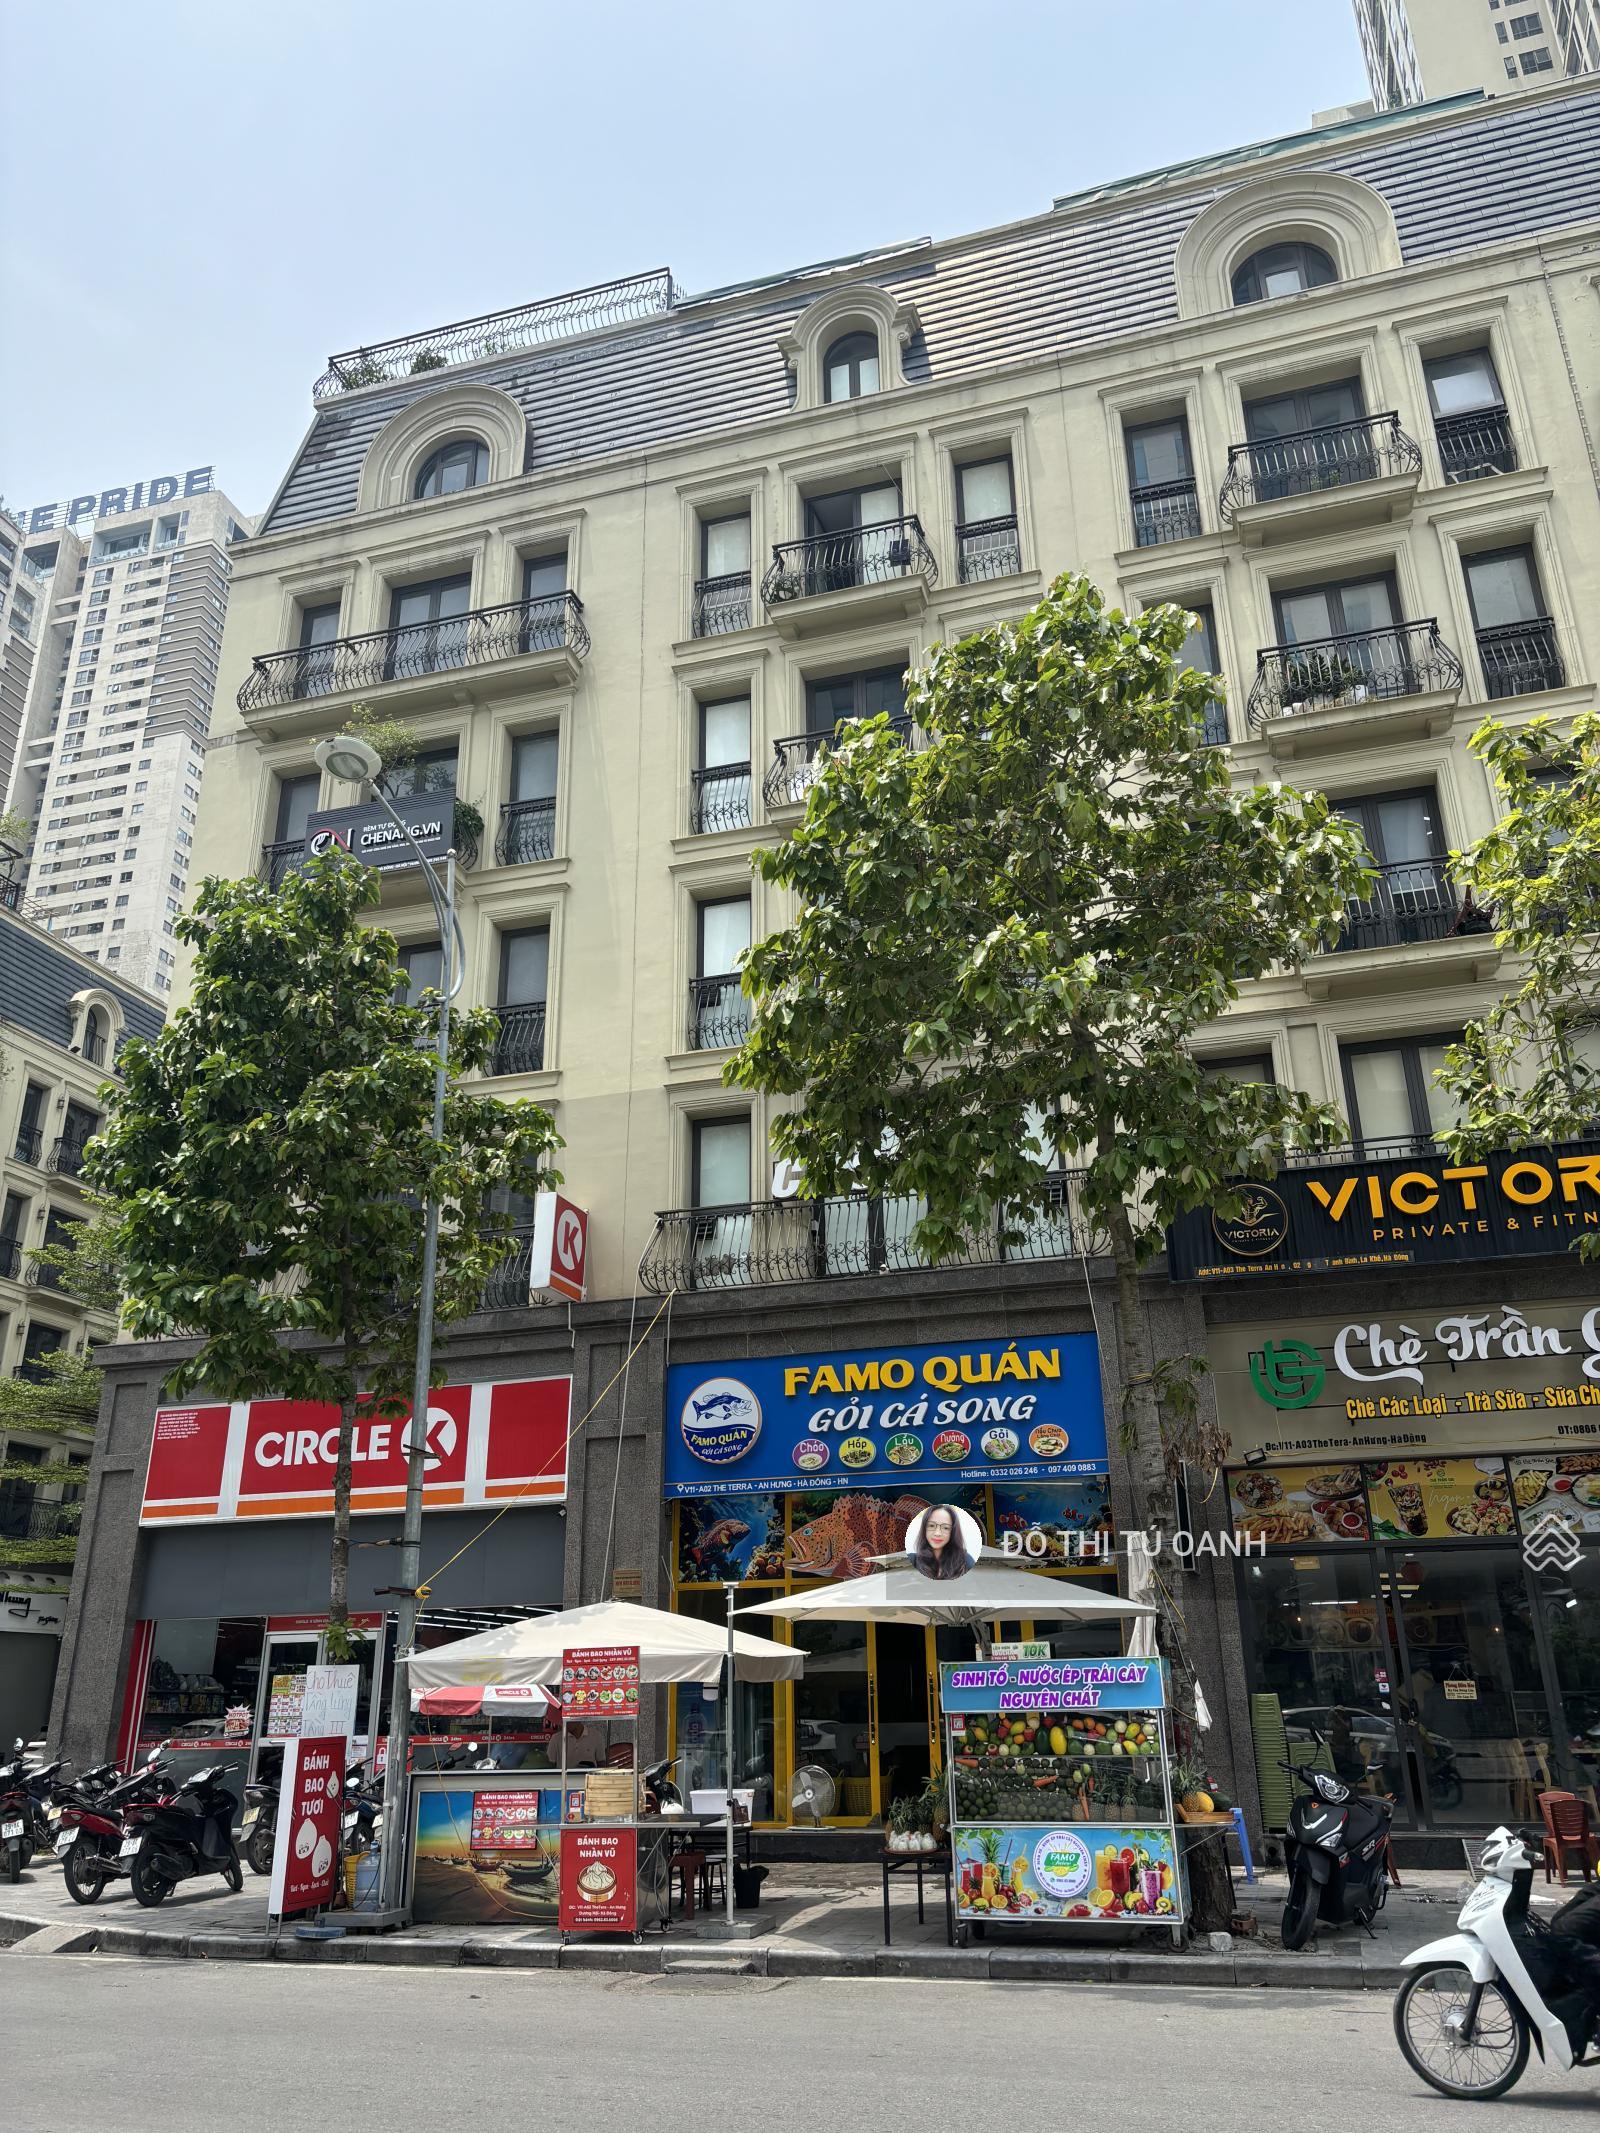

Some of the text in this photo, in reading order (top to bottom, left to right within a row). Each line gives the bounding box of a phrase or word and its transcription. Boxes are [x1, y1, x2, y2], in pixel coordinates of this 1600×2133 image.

[68, 466, 213, 526] PRIDE
[1224, 1228, 1279, 1239] VICTORIA
[1373, 1220, 1489, 1241] PRIVATE
[1507, 1218, 1520, 1230] &
[1334, 1323, 1427, 1386] Chè
[1435, 1305, 1572, 1361] Trần
[784, 1341, 1061, 1396] FAMO QUÁN
[1346, 1396, 1376, 1419] Chè
[1380, 1395, 1410, 1417] Các
[1412, 1393, 1448, 1419] Loại
[1465, 1391, 1492, 1412] Trà
[1494, 1388, 1527, 1410] Sữa
[1544, 1385, 1577, 1407] Sữa
[808, 1393, 1038, 1432] GỎI CÁ SONG
[691, 1428, 748, 1447] FAMO QUÁN
[847, 1437, 867, 1450] Hấp
[724, 1443, 743, 1453] SONG
[961, 1463, 1097, 1478] Hotline: 0332 026 246 097 409 0883
[712, 1484, 727, 1492] THE
[728, 1483, 753, 1491] TERRA
[770, 1480, 792, 1488] HƯNG
[797, 1479, 809, 1487] HÀ
[809, 1477, 832, 1487] ĐÔNG
[837, 1477, 849, 1485] HN
[572, 1650, 590, 1658] BÁNH
[1023, 1643, 1048, 1658] 10K
[307, 1670, 356, 1690] Cho Thuê
[952, 1670, 988, 1687] SINH
[988, 1663, 1009, 1687] TỐ
[1018, 1665, 1060, 1686] NƯỚC
[1061, 1663, 1082, 1685] ÉP
[1083, 1663, 1115, 1684] TRÁI
[1117, 1663, 1149, 1683] CÂY
[1000, 1684, 1102, 1709] NGUYÊN CHẤT
[303, 1749, 330, 1771] BÁNH
[305, 1777, 325, 1794] BAO
[301, 1799, 324, 1817] TƯƠI
[577, 1834, 600, 1846] BÁNH
[604, 1847, 616, 1858] VŨ
[1050, 1853, 1076, 1861] FAMO
